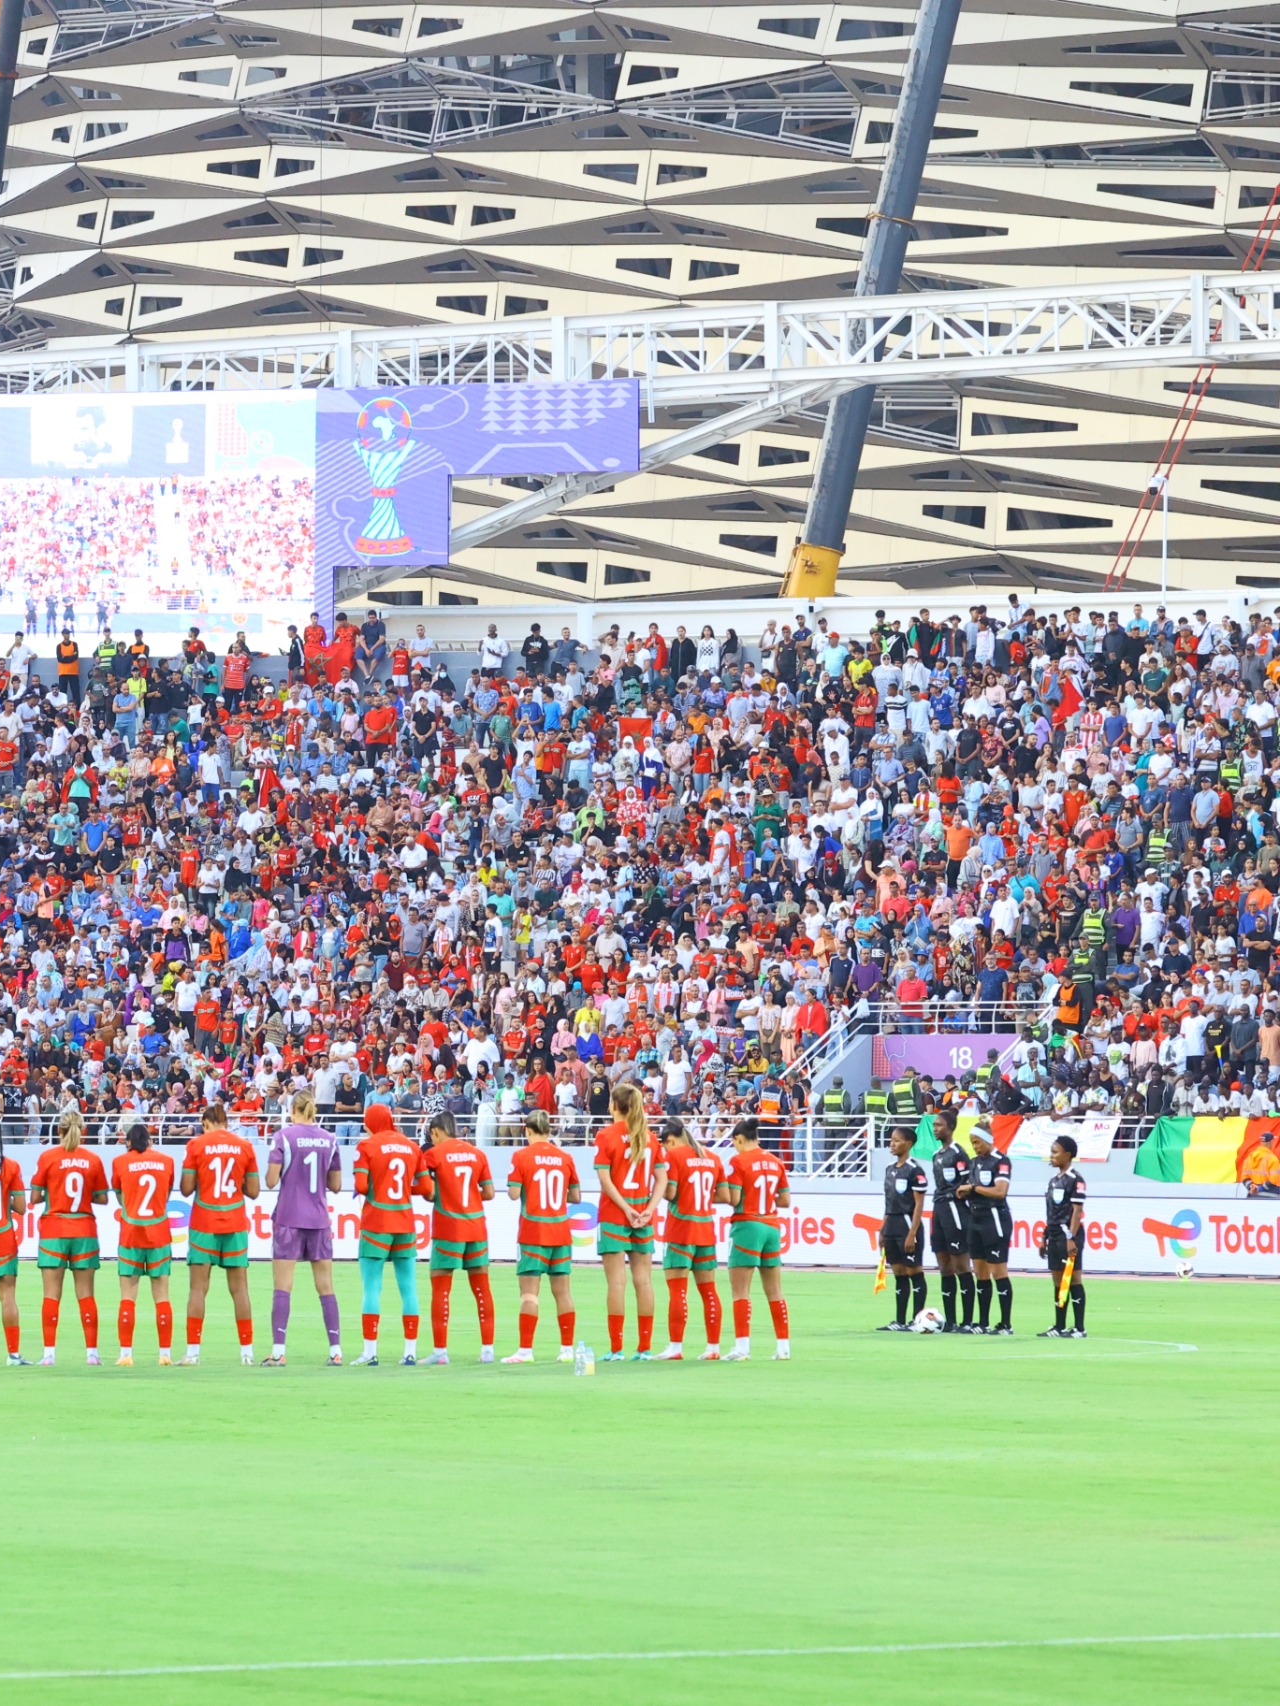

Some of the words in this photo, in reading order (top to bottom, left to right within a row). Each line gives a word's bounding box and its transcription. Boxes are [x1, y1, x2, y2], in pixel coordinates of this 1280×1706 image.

[949, 1046, 972, 1069] 18
[59, 1157, 90, 1169] JRAIDI
[128, 1160, 165, 1172] REDOUANI
[205, 1144, 241, 1155] RABBAH
[381, 1144, 413, 1155] BENZINA
[534, 1155, 562, 1166] BADRI
[65, 1171, 84, 1213] 9
[208, 1156, 237, 1199] 14
[303, 1151, 318, 1194] 1
[387, 1157, 406, 1200] 3
[455, 1165, 472, 1208] 7
[533, 1168, 564, 1211] 10
[688, 1170, 715, 1212] 19
[137, 1173, 157, 1217] 2
[754, 1174, 779, 1215] 17
